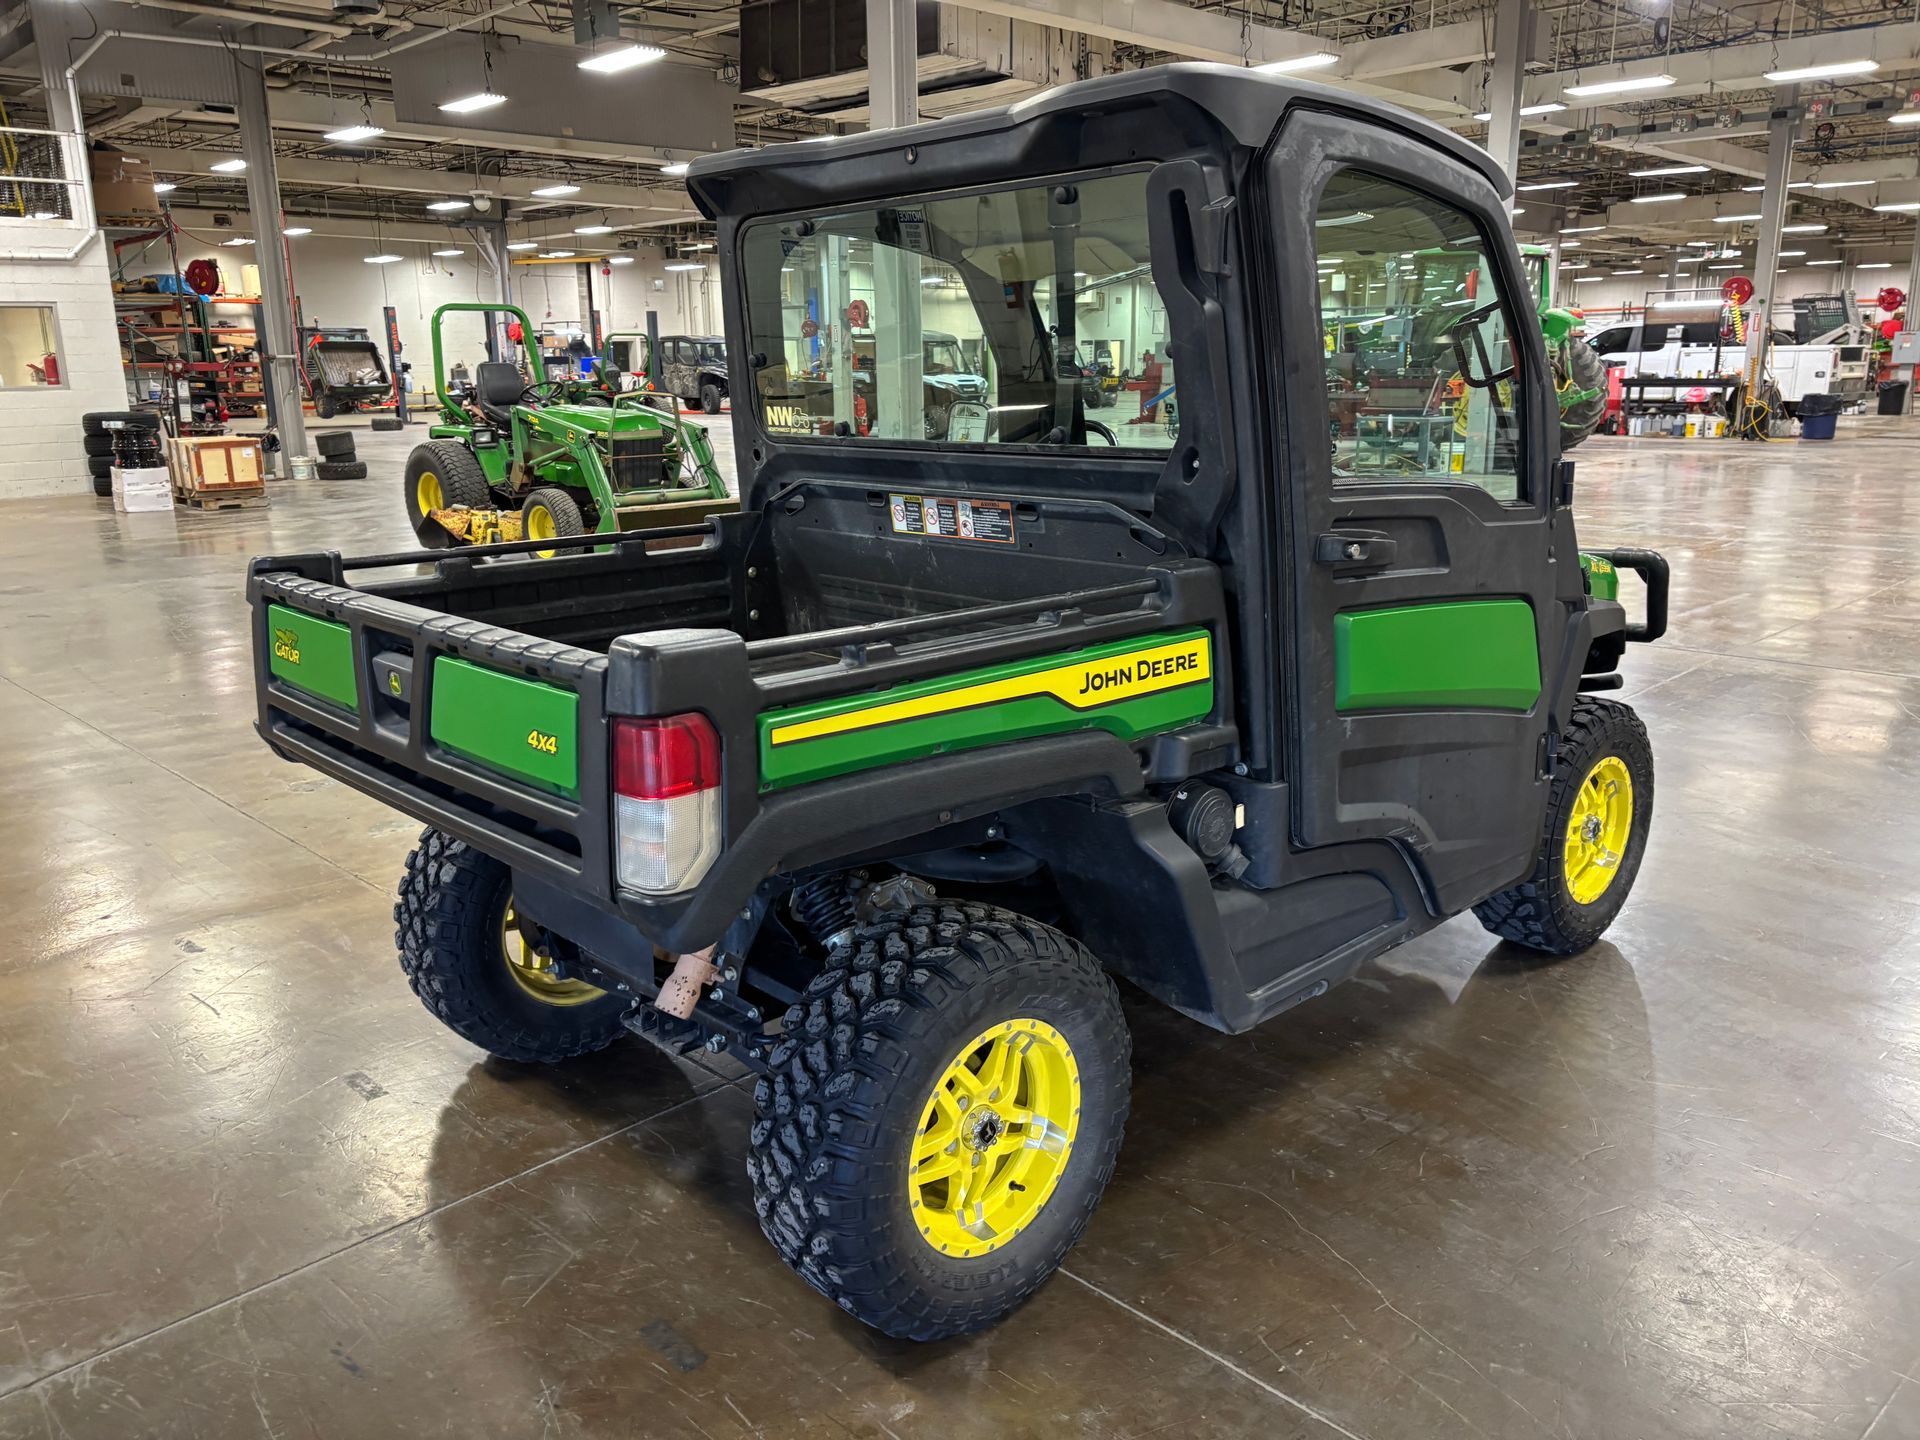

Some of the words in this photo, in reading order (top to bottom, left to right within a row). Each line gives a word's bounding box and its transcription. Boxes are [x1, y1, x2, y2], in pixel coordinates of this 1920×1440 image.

[766, 406, 792, 426] NW
[275, 641, 300, 664] GATOR
[1079, 666, 1132, 695] JOHN
[1137, 652, 1198, 681] DEERE
